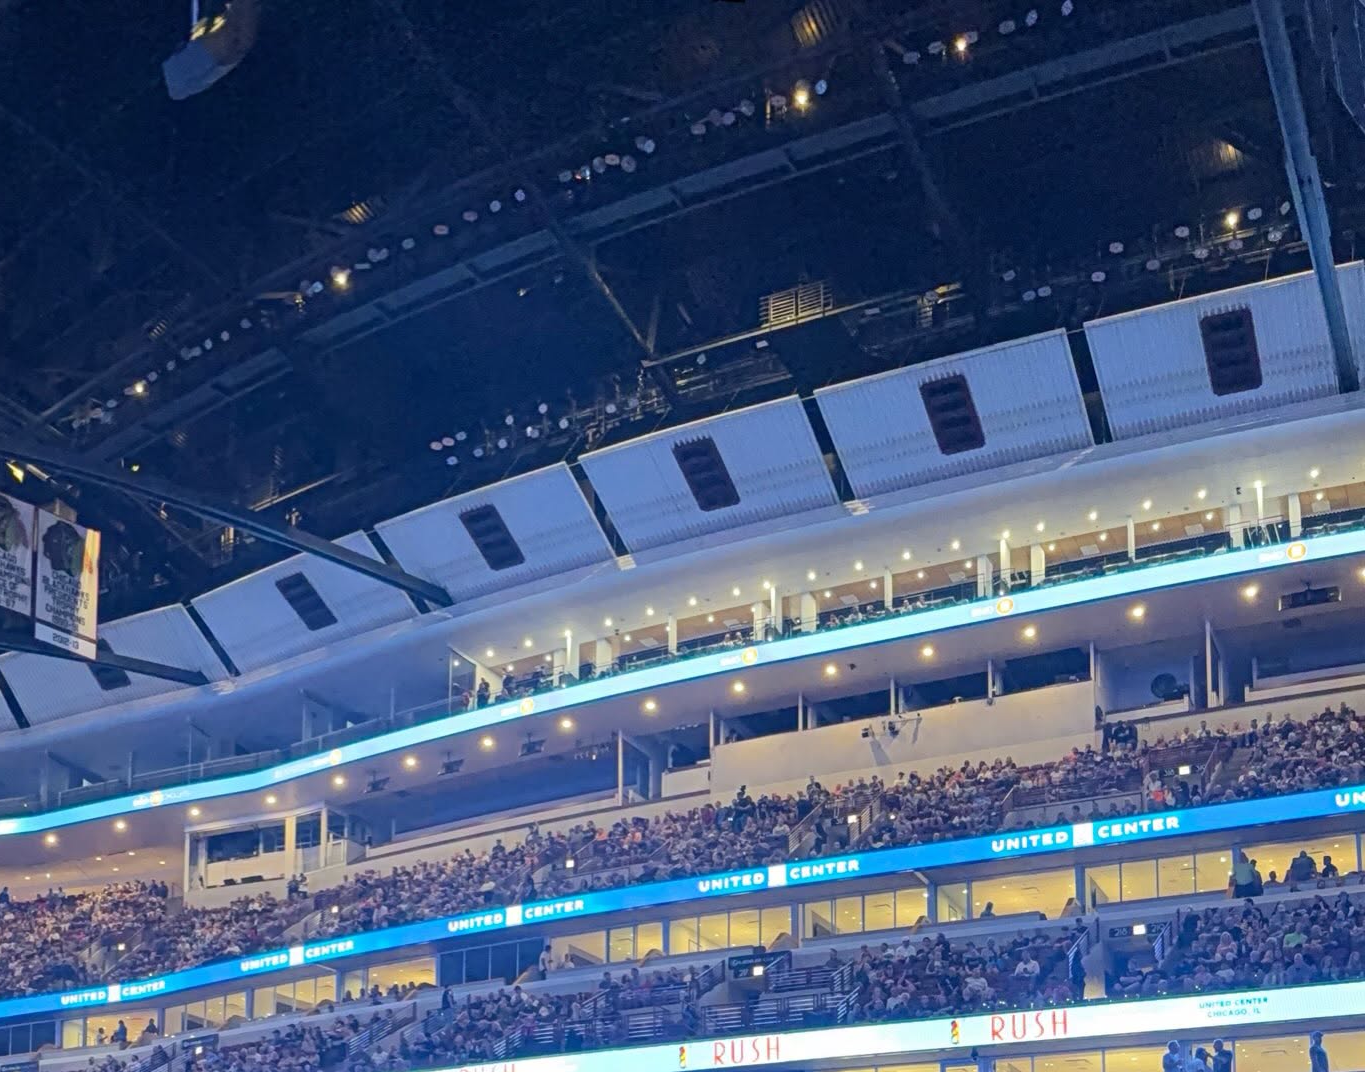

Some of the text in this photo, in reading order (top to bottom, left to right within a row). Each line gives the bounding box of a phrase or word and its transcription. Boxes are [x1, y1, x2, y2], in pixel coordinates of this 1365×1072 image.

[991, 816, 1180, 853] UNITED CENTER
[698, 859, 860, 893] UNITED CENTER
[448, 900, 585, 933] UNITED CENTER
[241, 941, 354, 973] UNITED CENTER
[60, 981, 166, 1006] UNITED CENTER
[991, 1009, 1068, 1041] RUSH
[713, 1037, 781, 1066] RUSH
